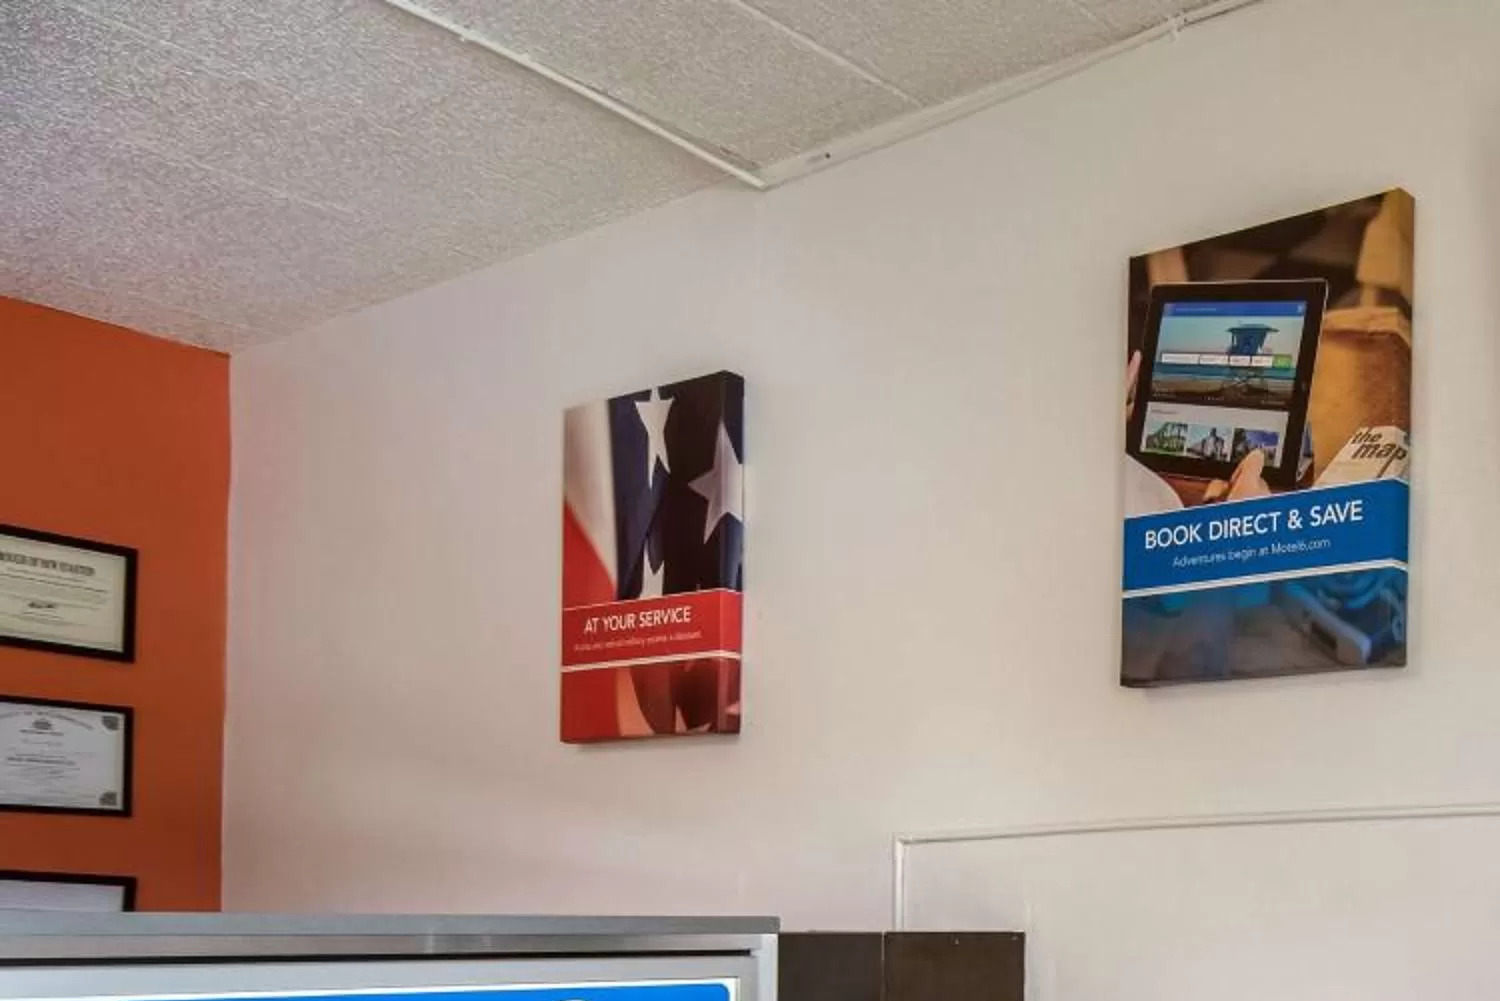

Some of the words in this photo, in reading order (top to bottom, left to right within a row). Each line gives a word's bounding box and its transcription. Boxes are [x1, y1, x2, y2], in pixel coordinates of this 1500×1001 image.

[1351, 427, 1383, 444] the
[1351, 443, 1407, 478] map
[1145, 522, 1203, 550] BOOK
[1209, 511, 1281, 541] DIRECT
[1287, 509, 1303, 530] &
[1309, 500, 1364, 527] SAVE
[1172, 551, 1227, 568] Adventures
[1227, 547, 1257, 562] begin
[584, 617, 599, 634] AT
[601, 613, 635, 632] YOUR
[639, 605, 693, 628] SERVICE
